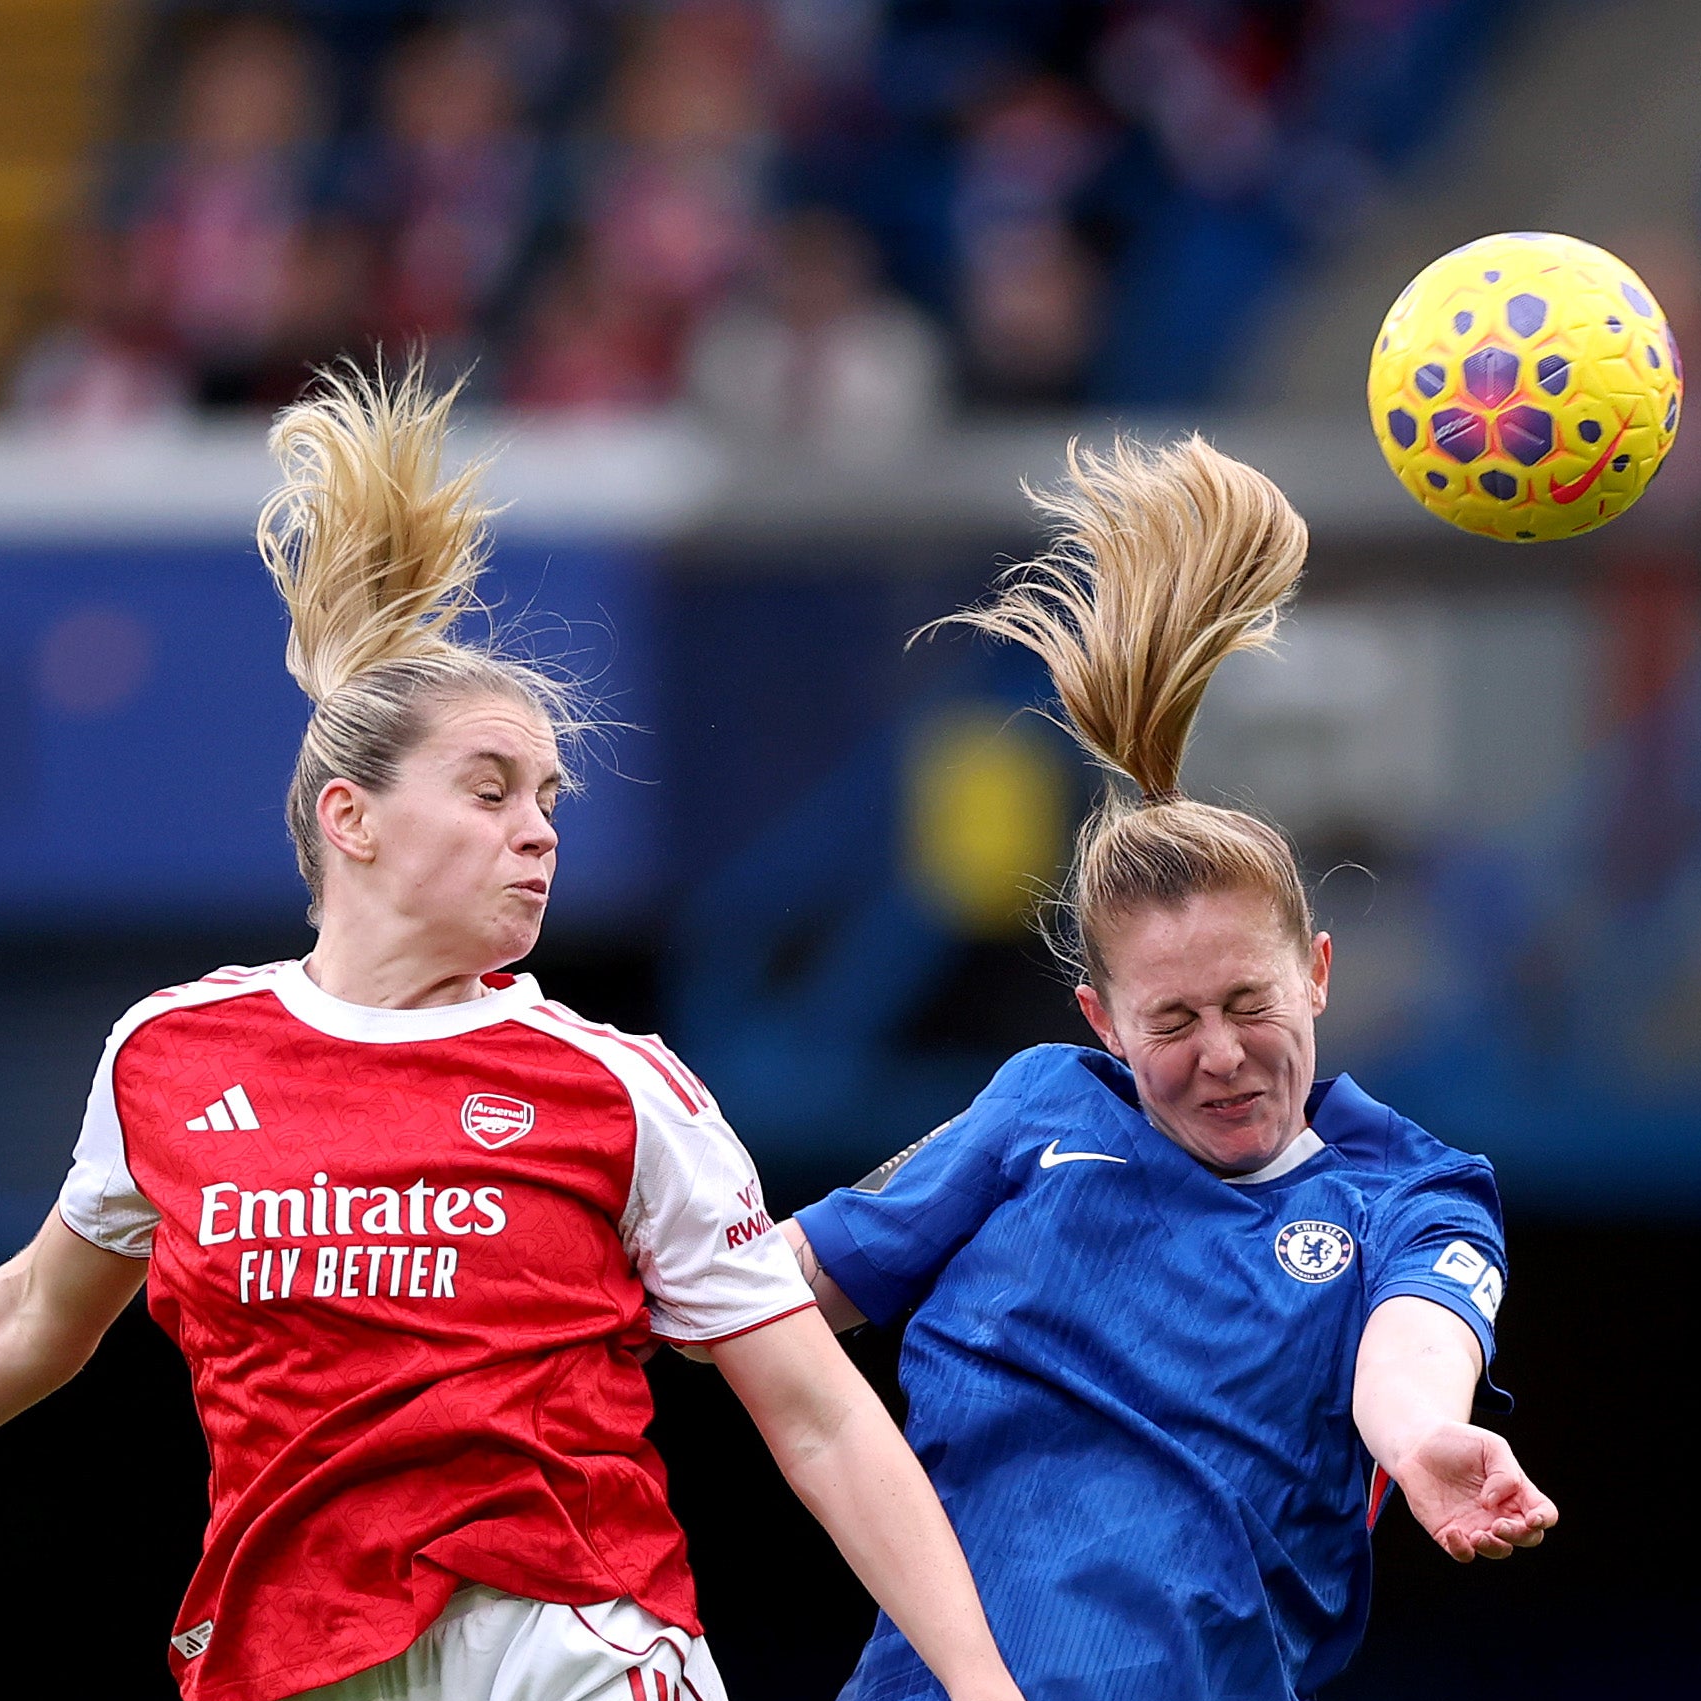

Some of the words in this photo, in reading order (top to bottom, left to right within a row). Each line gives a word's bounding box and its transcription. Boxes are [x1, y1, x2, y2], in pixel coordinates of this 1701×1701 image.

[473, 1102, 524, 1120] Arsenal
[199, 1171, 507, 1246] Emirates
[1294, 1223, 1344, 1240] CHELSEA
[239, 1248, 301, 1304] FLY
[312, 1246, 458, 1298] BETTER
